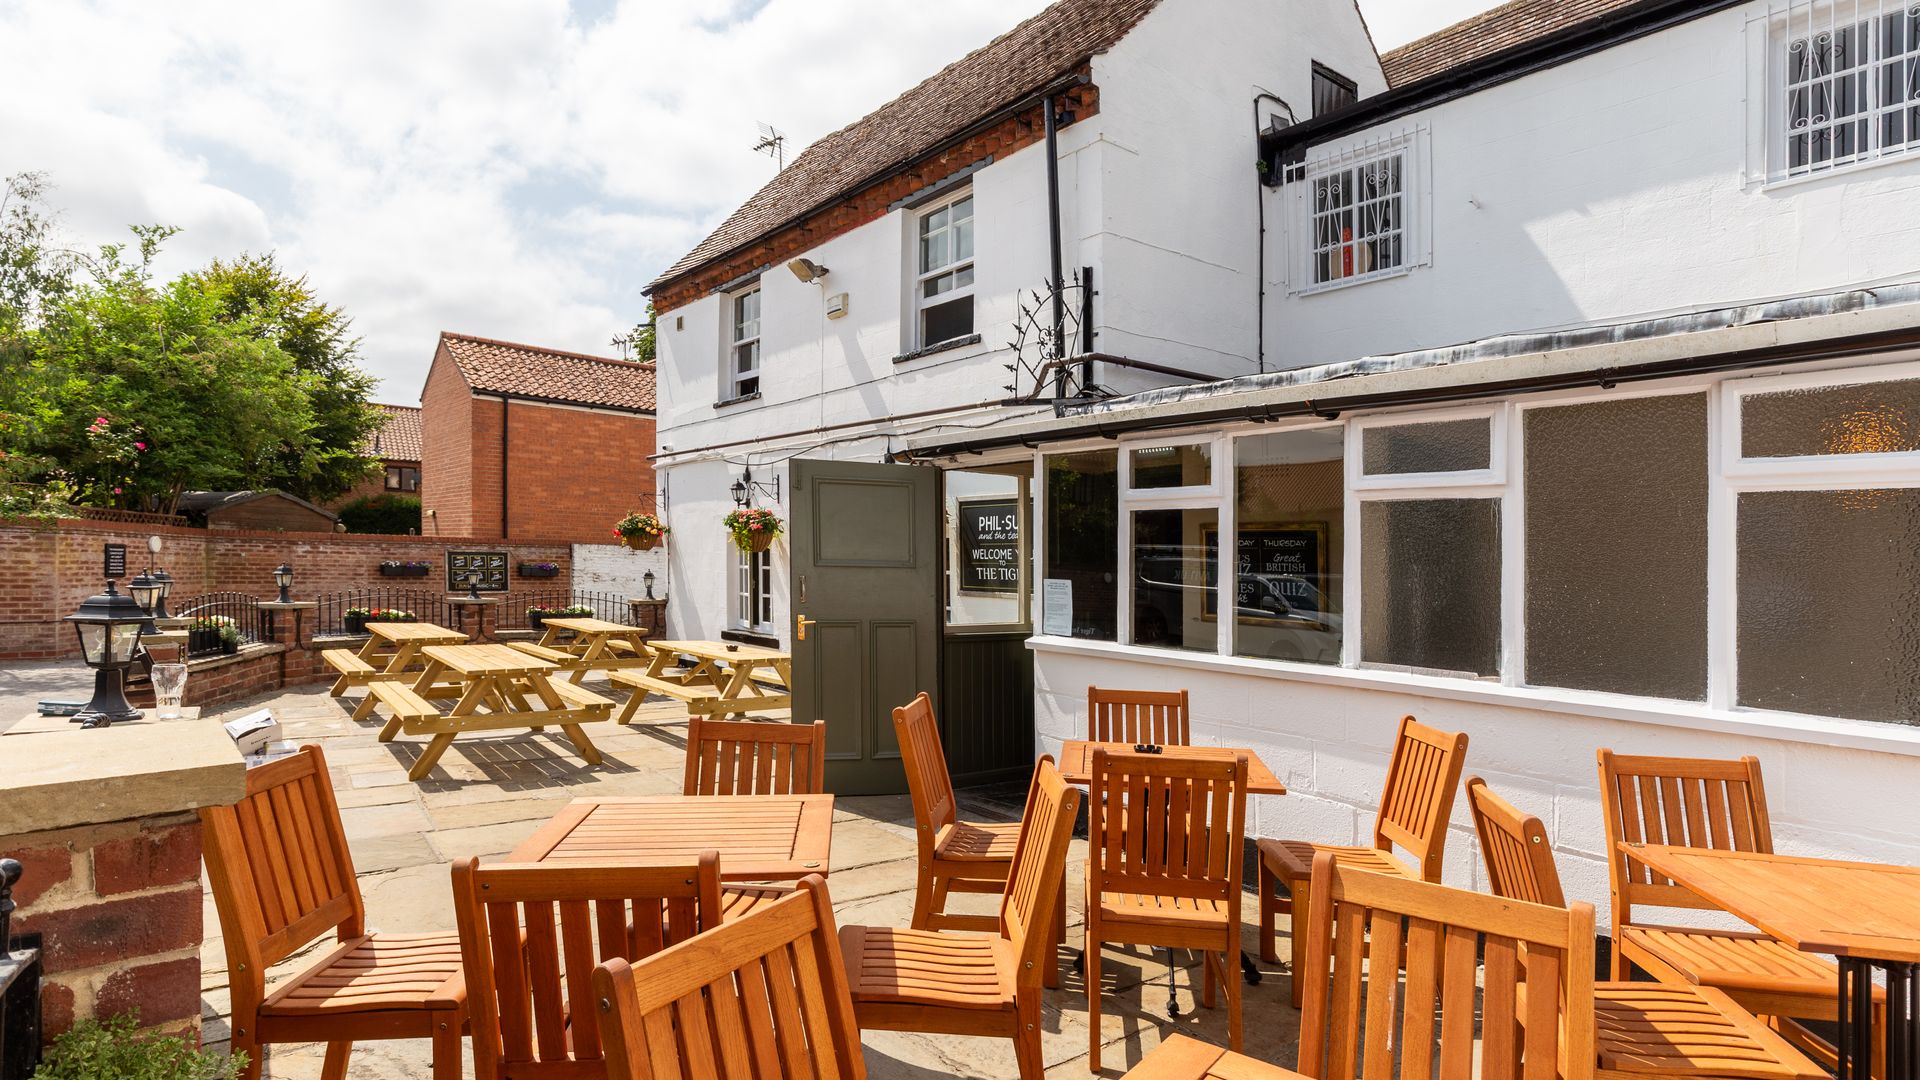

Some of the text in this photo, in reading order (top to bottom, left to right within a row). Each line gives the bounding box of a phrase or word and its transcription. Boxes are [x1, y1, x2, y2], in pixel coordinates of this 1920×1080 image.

[978, 531, 993, 540] and
[994, 531, 1006, 540] the
[1263, 539, 1307, 547] THURSDAY
[972, 548, 1013, 560] WELCOME
[1273, 552, 1301, 563] Great
[1266, 562, 1306, 572] BRITISH
[976, 567, 1019, 580] THE TIG
[1269, 580, 1307, 597] QUIZ
